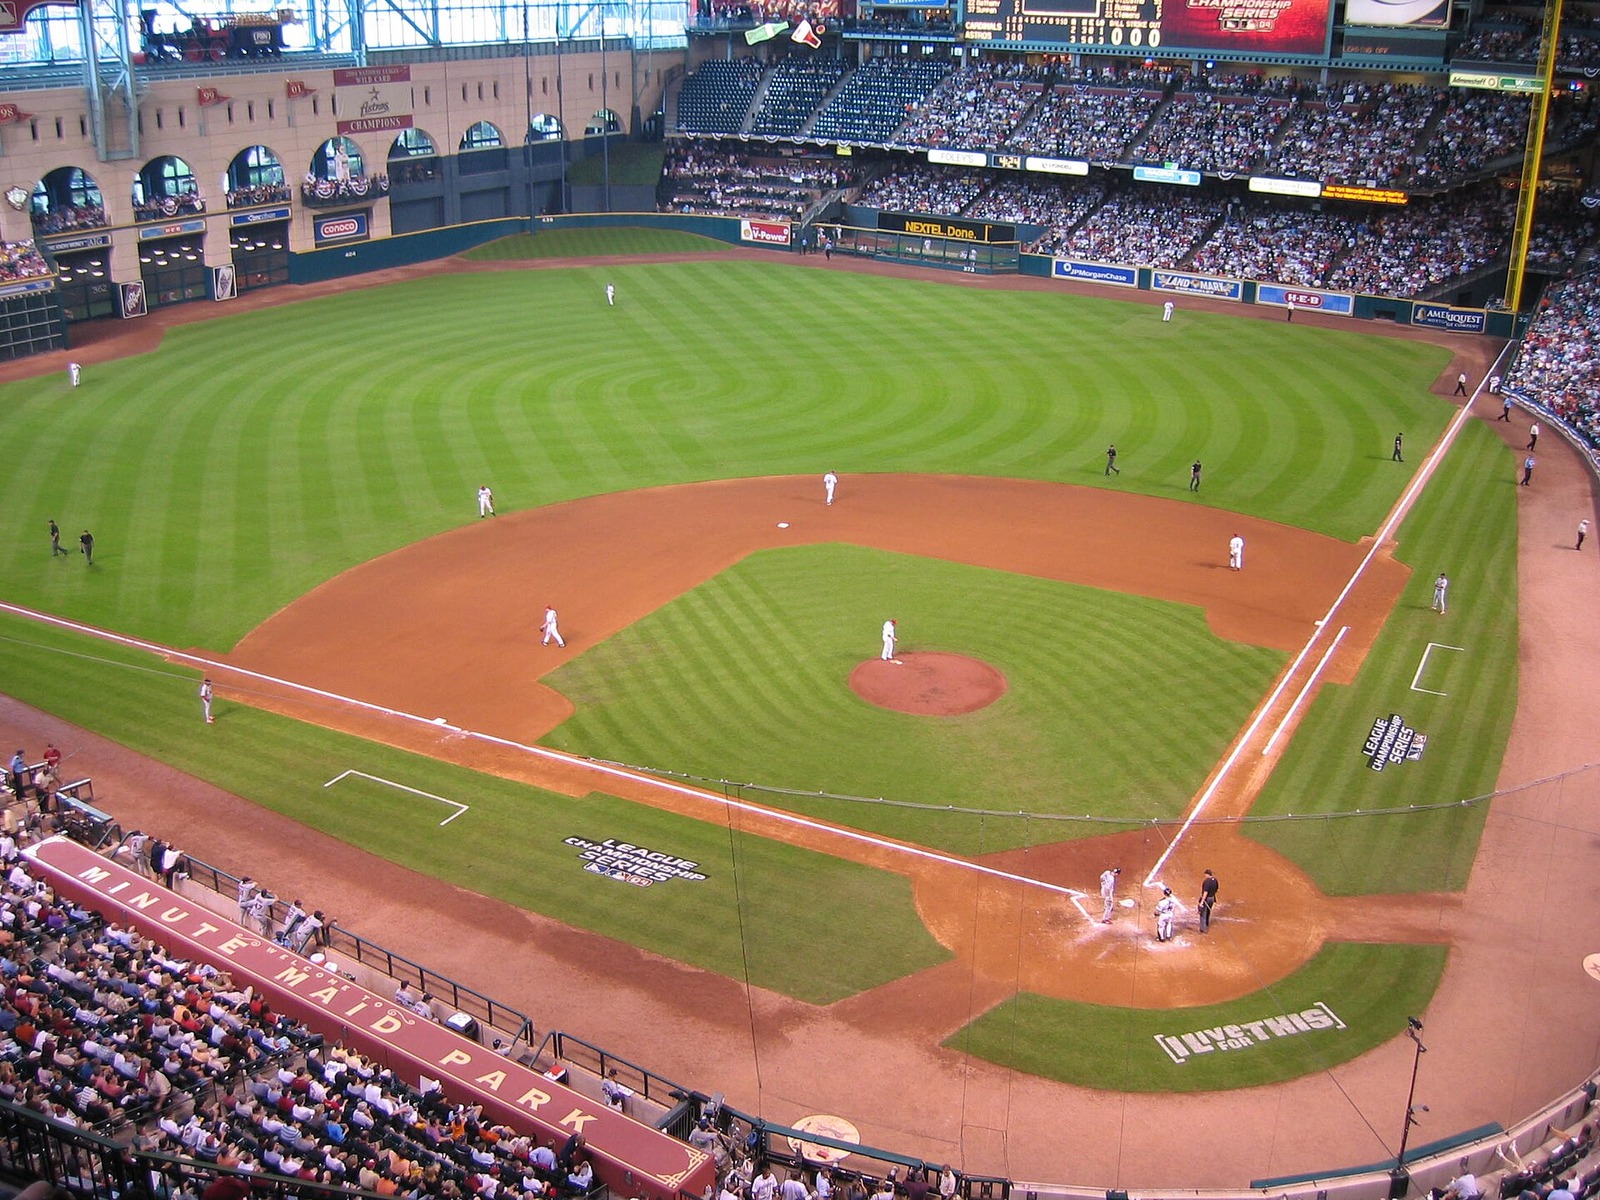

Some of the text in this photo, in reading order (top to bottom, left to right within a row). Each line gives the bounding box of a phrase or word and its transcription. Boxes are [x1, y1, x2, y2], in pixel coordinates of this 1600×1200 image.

[1188, 0, 1292, 9] CHAMPIONSHIP
[1222, 8, 1279, 18] SERIES
[965, 21, 1002, 31] CARDINALS
[964, 31, 993, 40] ASTROS
[1111, 28, 1160, 47] 0 0 0
[356, 74, 391, 84] WILD CARD
[203, 90, 215, 100] 99
[291, 85, 302, 94] 01
[0, 106, 14, 118] 98
[360, 101, 389, 117] Astros
[350, 117, 401, 131] CHAMPIONS
[941, 152, 974, 163] FOLEY'S
[752, 230, 788, 242] V-Power
[905, 221, 977, 240] NEXTEL. Done.
[1070, 268, 1127, 281] JPMorganChase
[1166, 276, 1225, 293] LAND MARK
[1362, 718, 1388, 756] LEAGUE
[1371, 715, 1402, 771] CHAMPIONSHIP
[1388, 726, 1414, 764] SERIES
[564, 837, 707, 881] CHAMPIONSHIP
[602, 838, 698, 870] LEAGUE
[578, 850, 673, 882] SERIES
[266, 946, 383, 1008] WELCOME TO
[78, 866, 599, 1133] MINUTE MAID PARK
[1217, 1036, 1254, 1051] FOR
